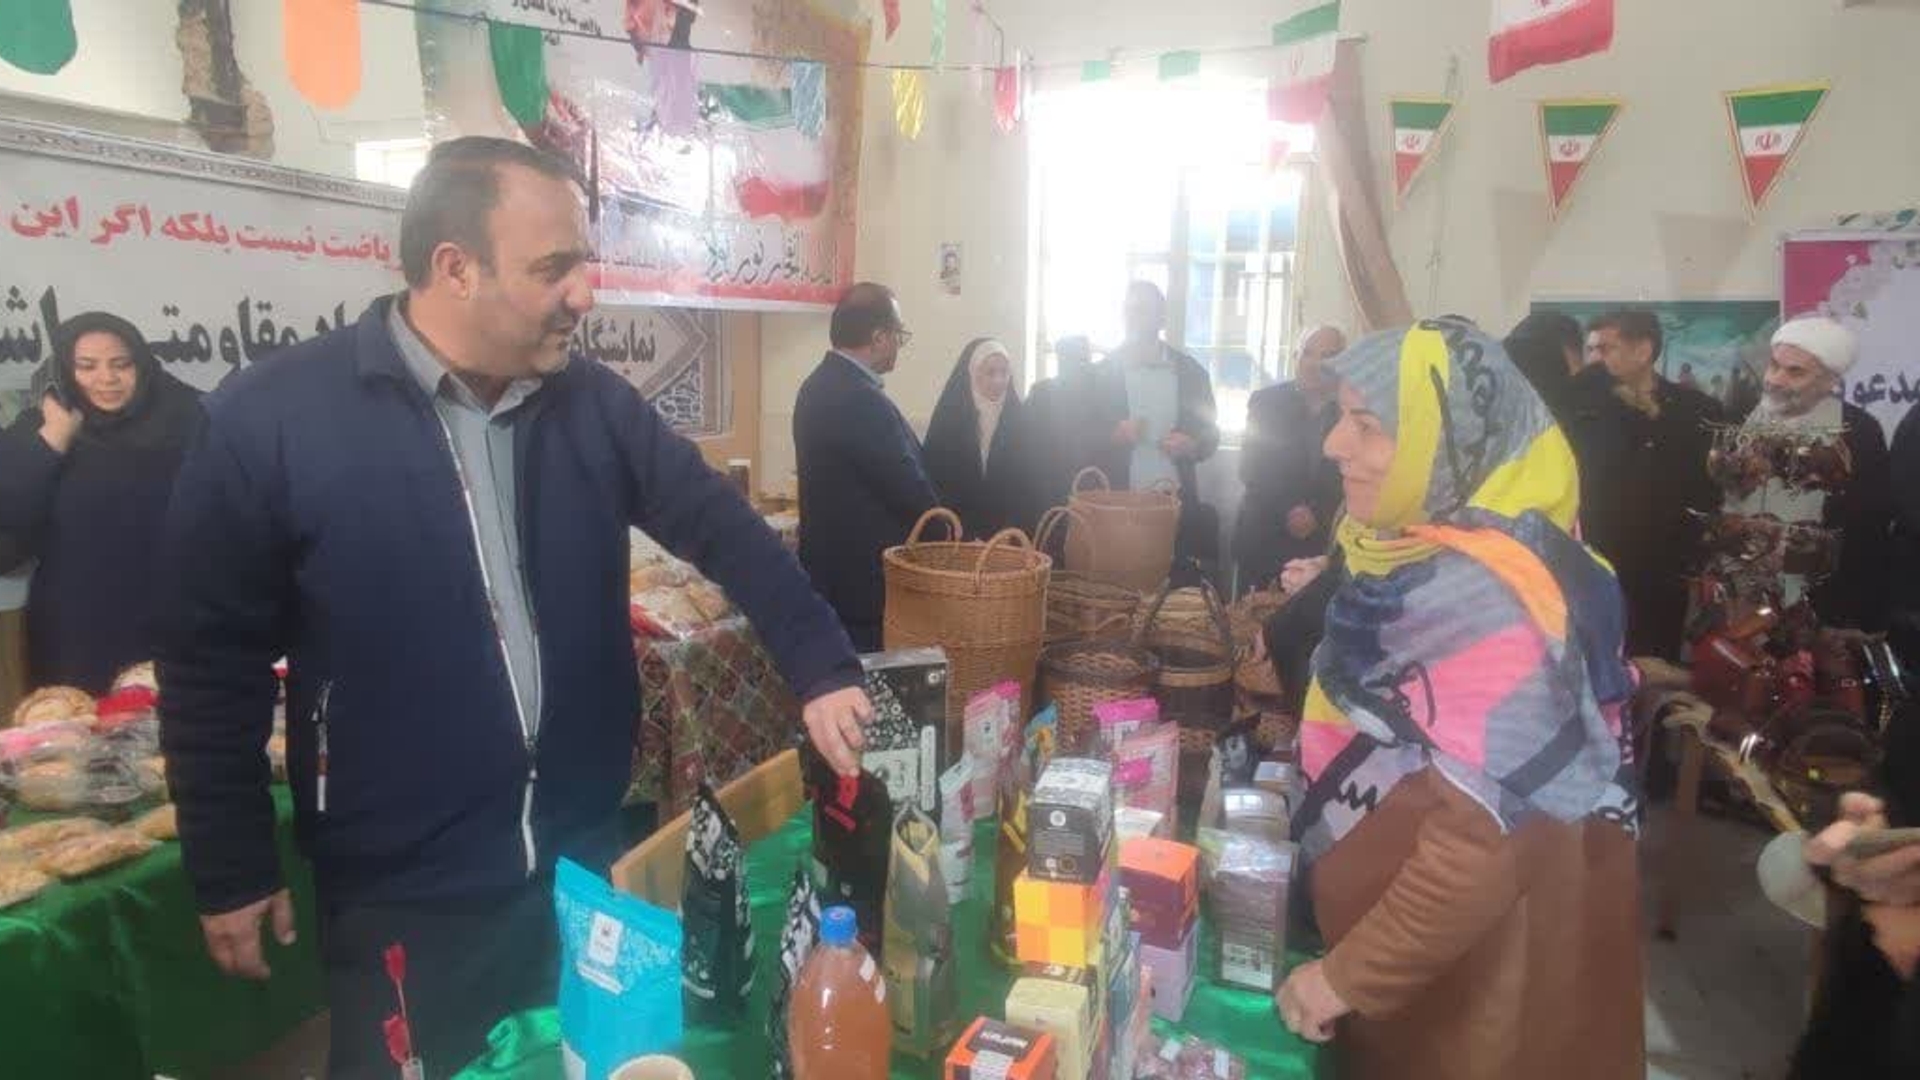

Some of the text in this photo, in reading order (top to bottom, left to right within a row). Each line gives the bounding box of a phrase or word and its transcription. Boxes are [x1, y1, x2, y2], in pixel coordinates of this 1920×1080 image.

[9, 195, 80, 238] این
[90, 203, 152, 245] اگر
[161, 213, 230, 254] بلکه
[236, 225, 316, 261] نیست
